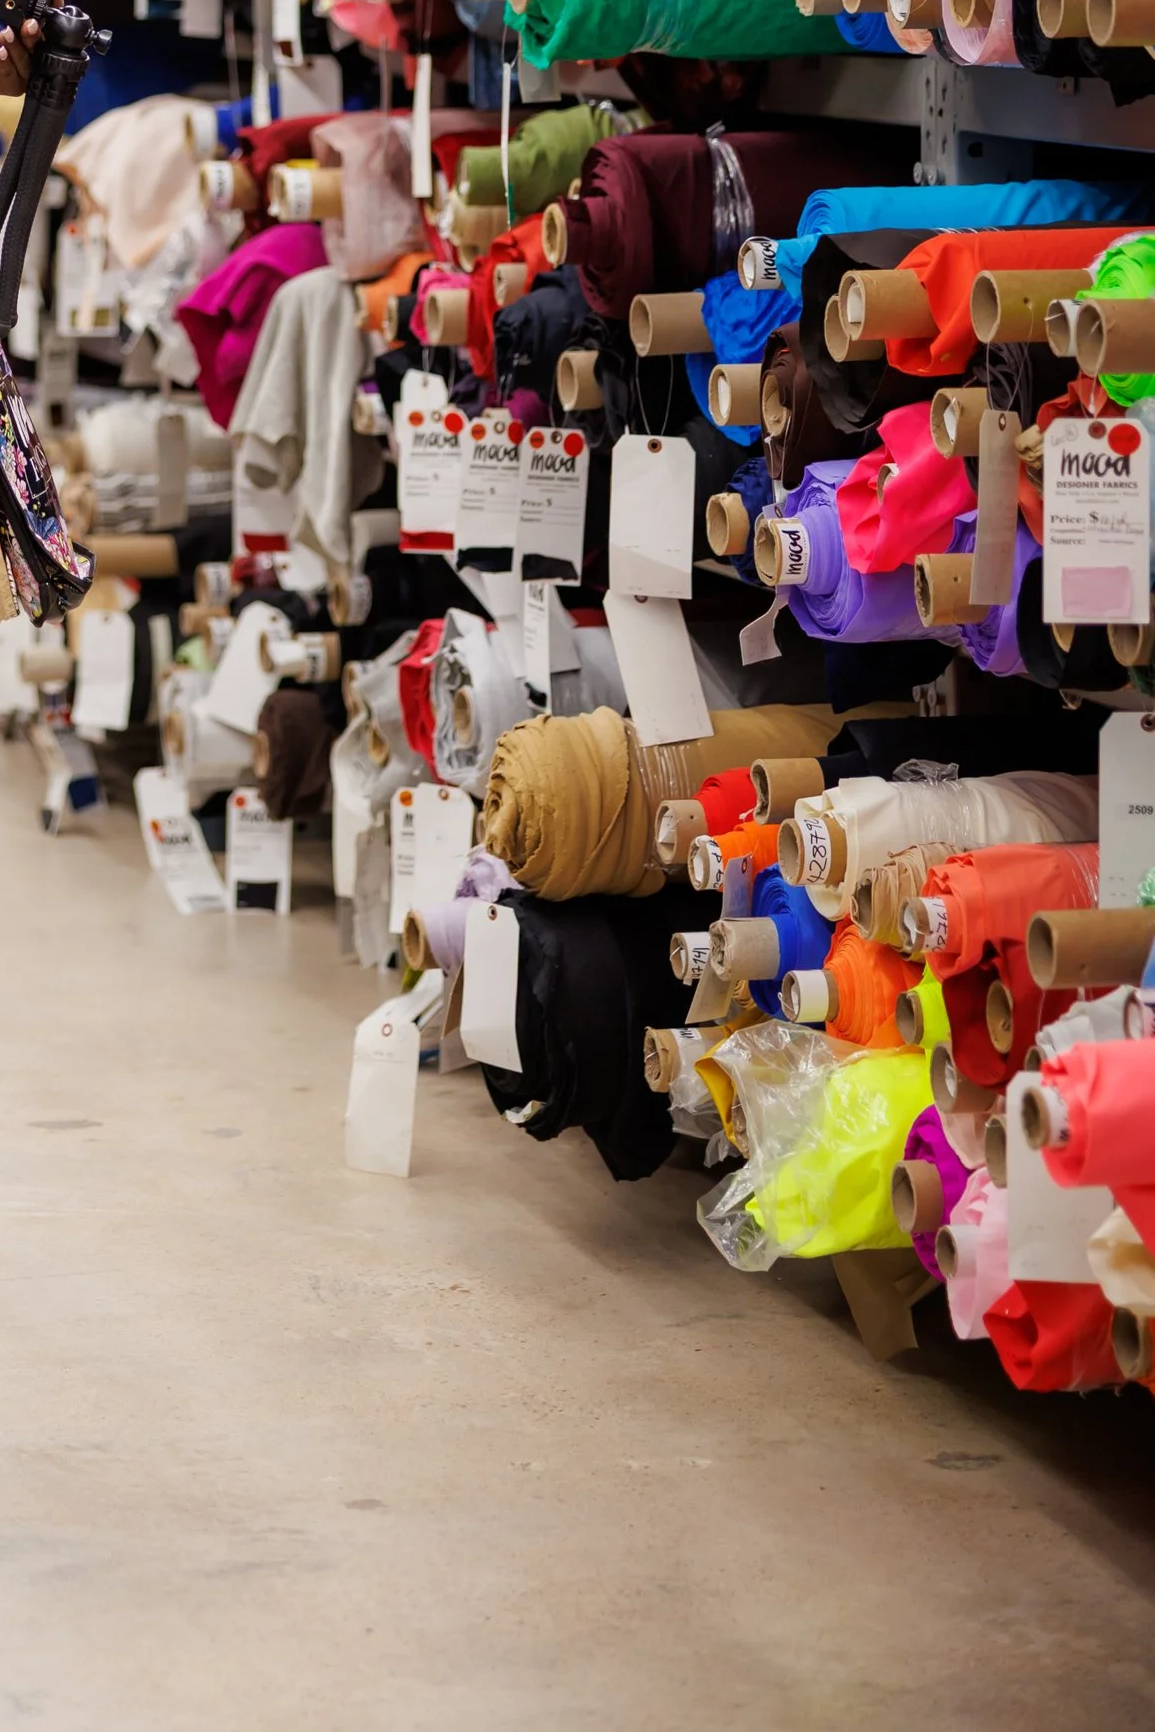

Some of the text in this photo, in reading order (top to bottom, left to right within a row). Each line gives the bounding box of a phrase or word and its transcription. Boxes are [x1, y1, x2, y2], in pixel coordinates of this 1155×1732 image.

[1060, 448, 1131, 479] mood
[1056, 480, 1139, 490] DESIGNER FABRICS
[1050, 514, 1086, 525] Price:
[1089, 510, 1099, 524] $
[1049, 536, 1086, 546] Source:
[782, 529, 804, 575] mood
[1128, 804, 1154, 816] 2509
